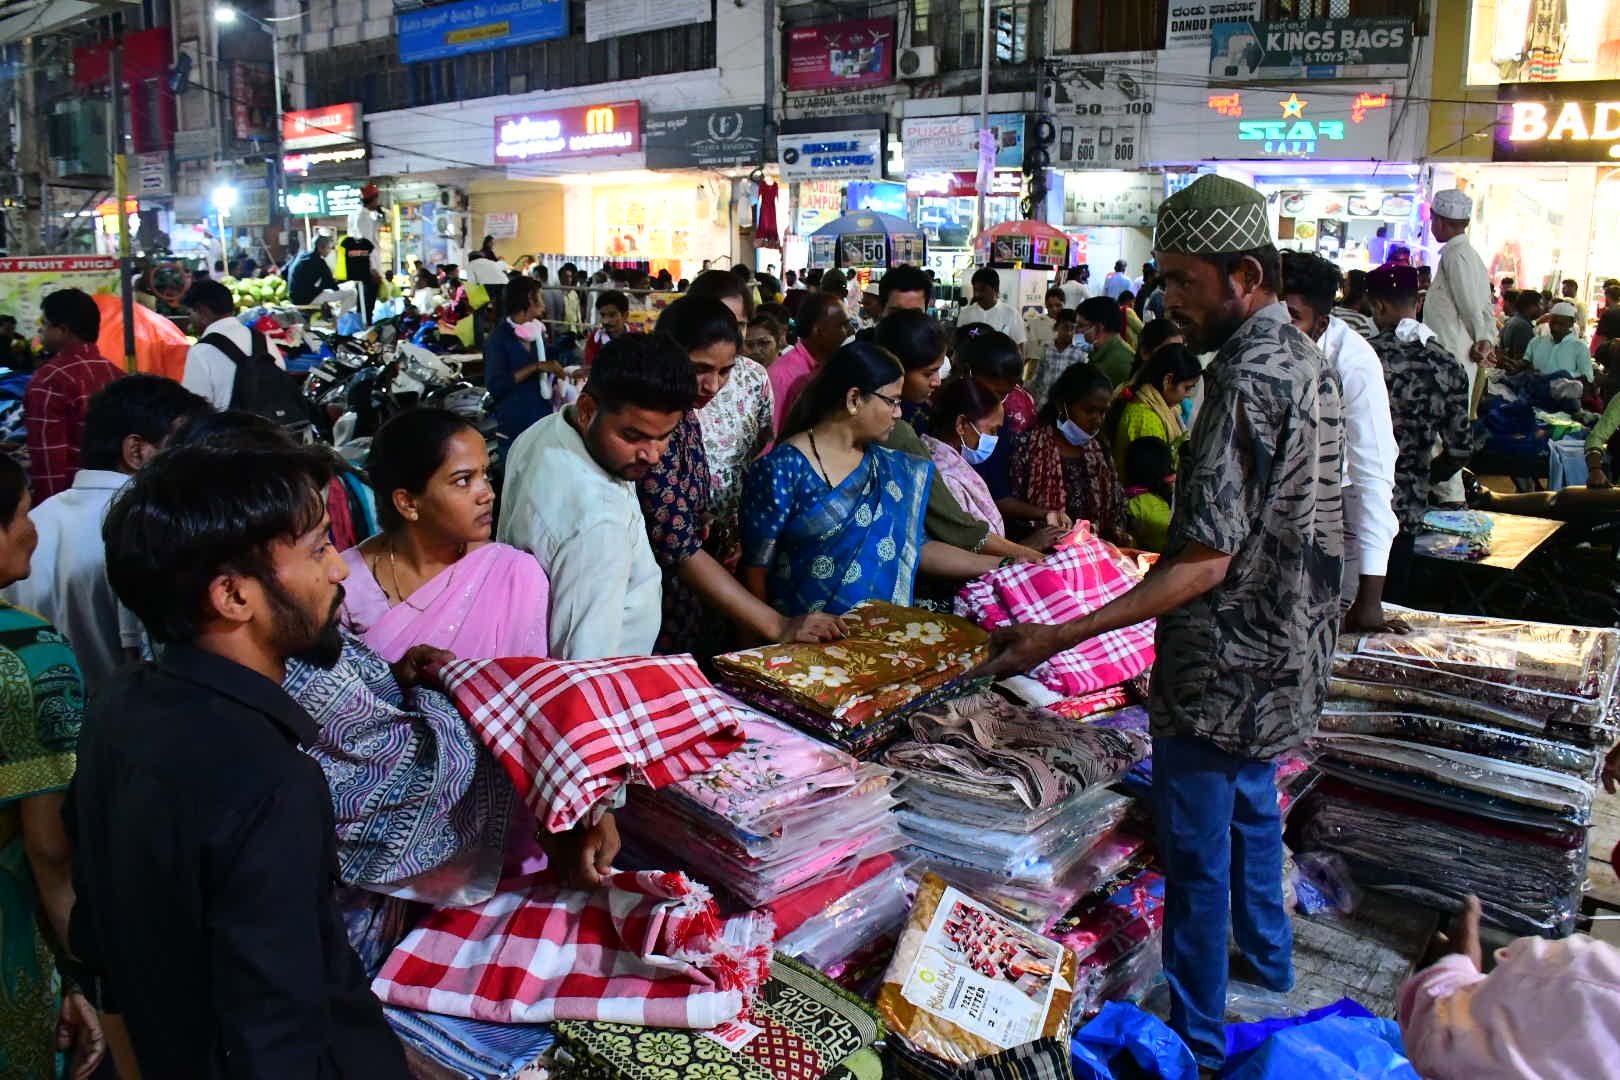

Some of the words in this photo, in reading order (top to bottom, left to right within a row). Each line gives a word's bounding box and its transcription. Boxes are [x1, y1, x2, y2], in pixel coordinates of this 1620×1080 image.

[1171, 19, 1206, 32] DANDU
[1266, 31, 1335, 51] KINGS
[1340, 28, 1404, 49] BAGS
[1314, 51, 1344, 62] TOYS
[1075, 103, 1102, 116] 50
[1125, 102, 1153, 115] 100
[1238, 121, 1344, 141] STAR
[1077, 145, 1095, 161] 600
[1115, 144, 1134, 161] 800
[864, 244, 884, 261] 50
[1014, 240, 1030, 258] 50
[18, 260, 64, 270] FRUIT
[70, 259, 113, 269] JUICE
[967, 987, 987, 1018] FITTED
